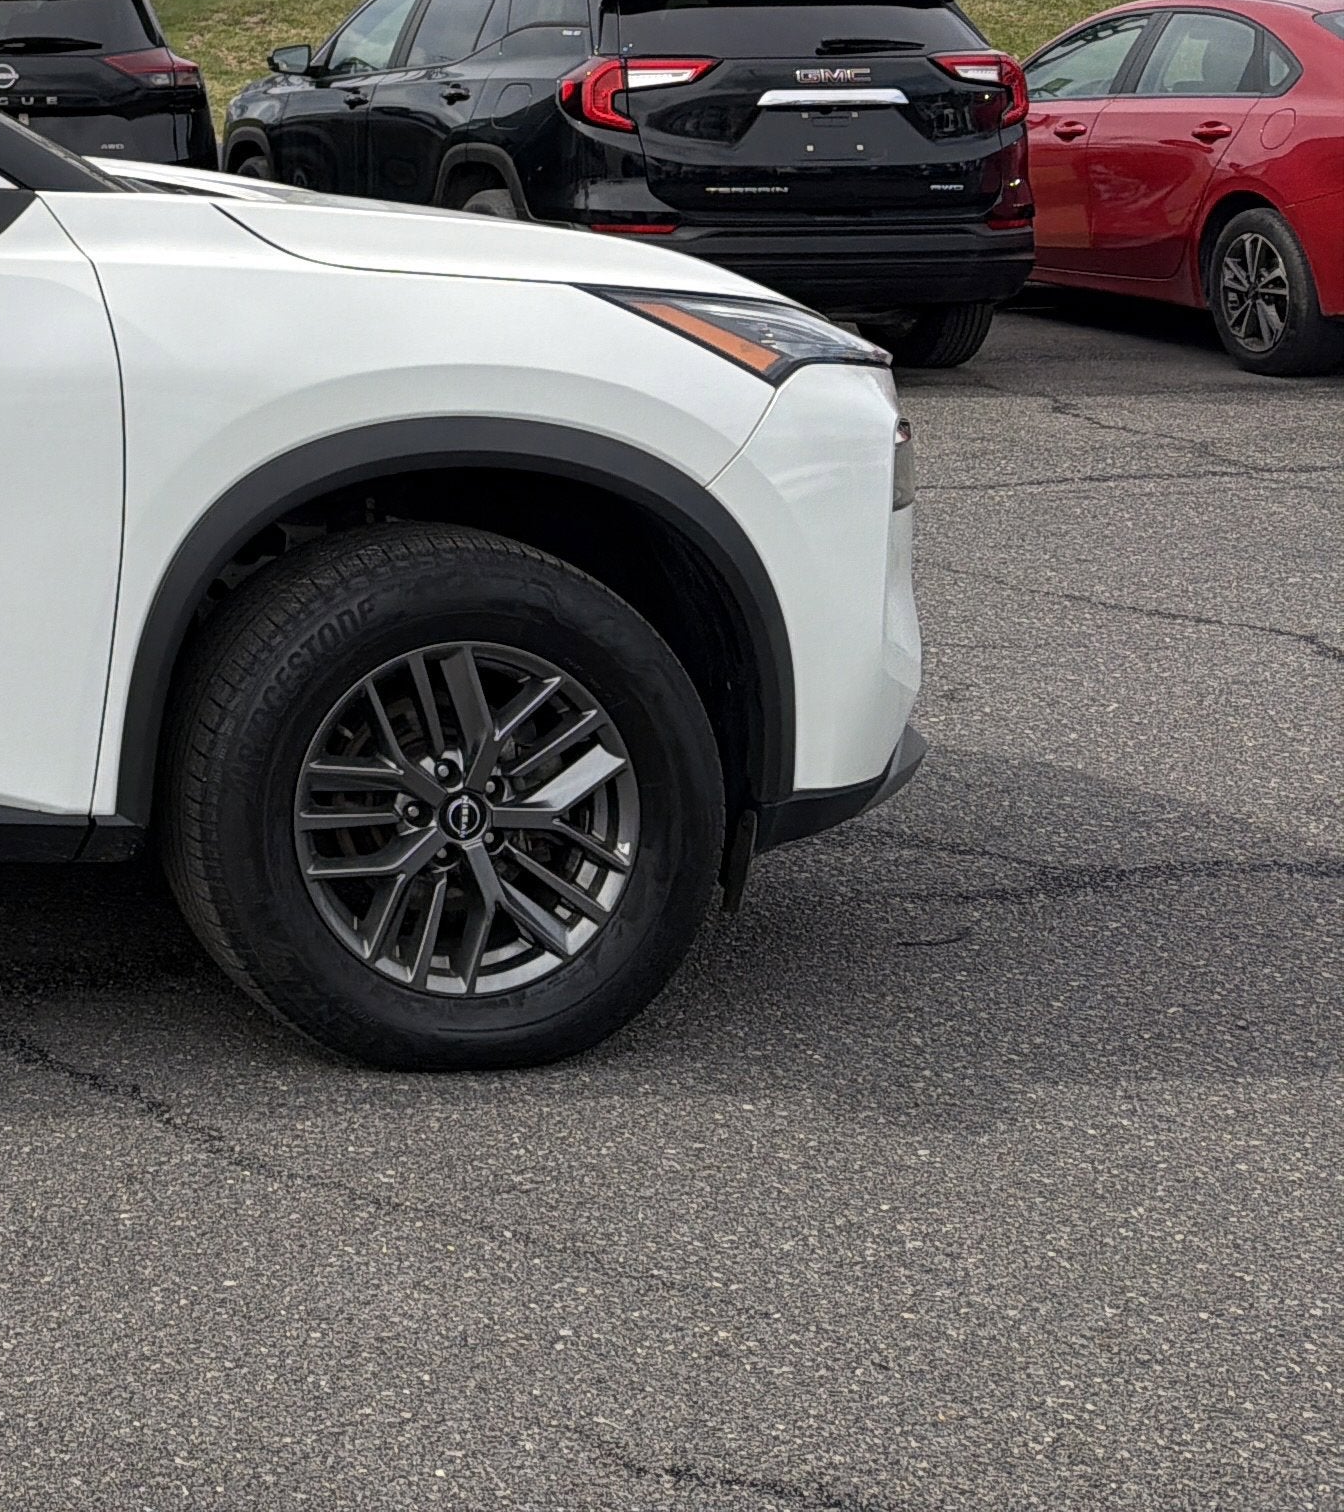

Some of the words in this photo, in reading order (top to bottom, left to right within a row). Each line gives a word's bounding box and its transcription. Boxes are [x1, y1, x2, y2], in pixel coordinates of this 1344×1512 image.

[795, 67, 872, 83] GMC
[705, 185, 789, 194] TERRAIN
[930, 183, 964, 191] AWD
